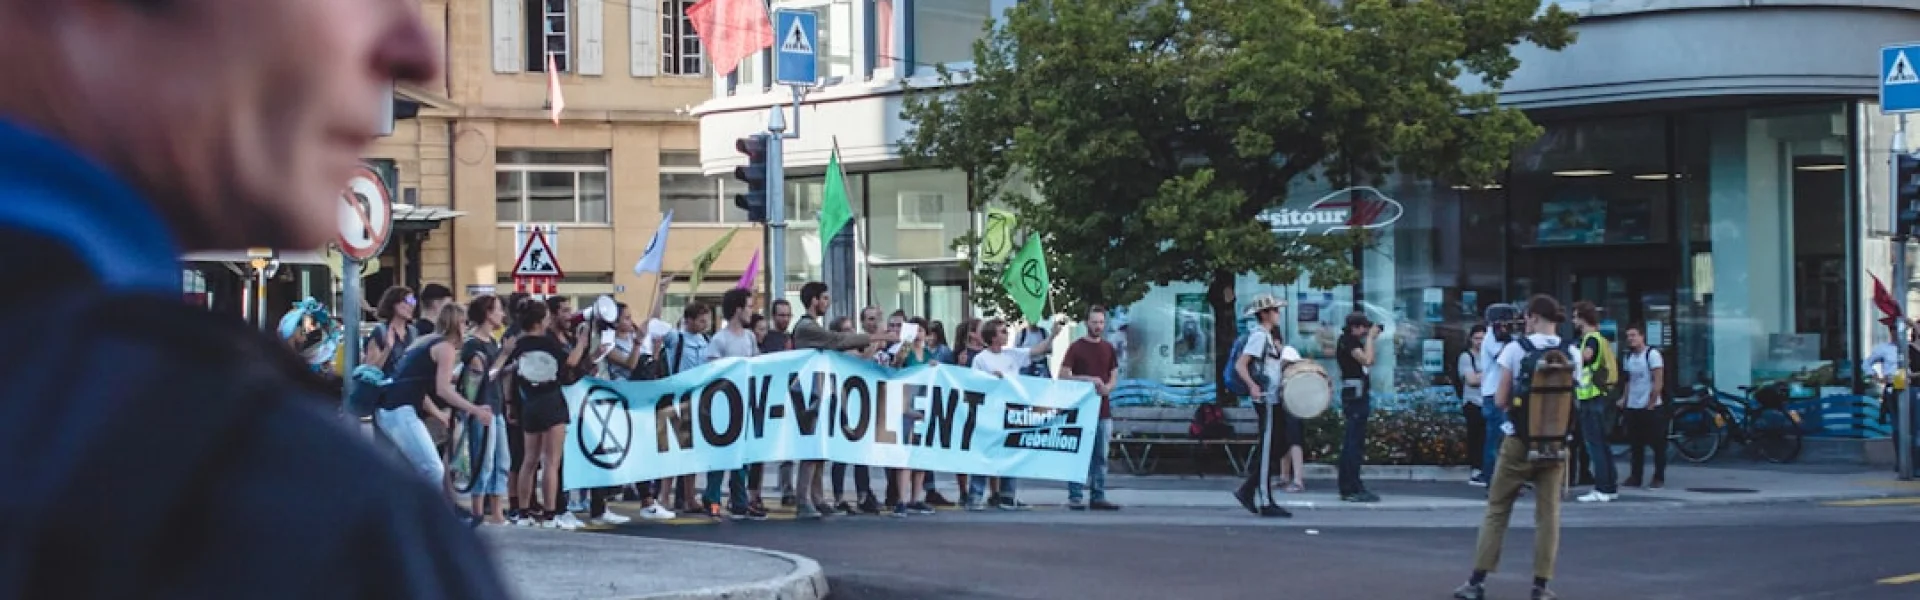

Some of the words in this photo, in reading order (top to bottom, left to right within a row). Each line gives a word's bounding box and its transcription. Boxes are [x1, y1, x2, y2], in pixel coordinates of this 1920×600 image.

[1255, 208, 1347, 226] isitour
[655, 370, 986, 453] NON-VIOLENT
[1018, 427, 1078, 450] rebellion
